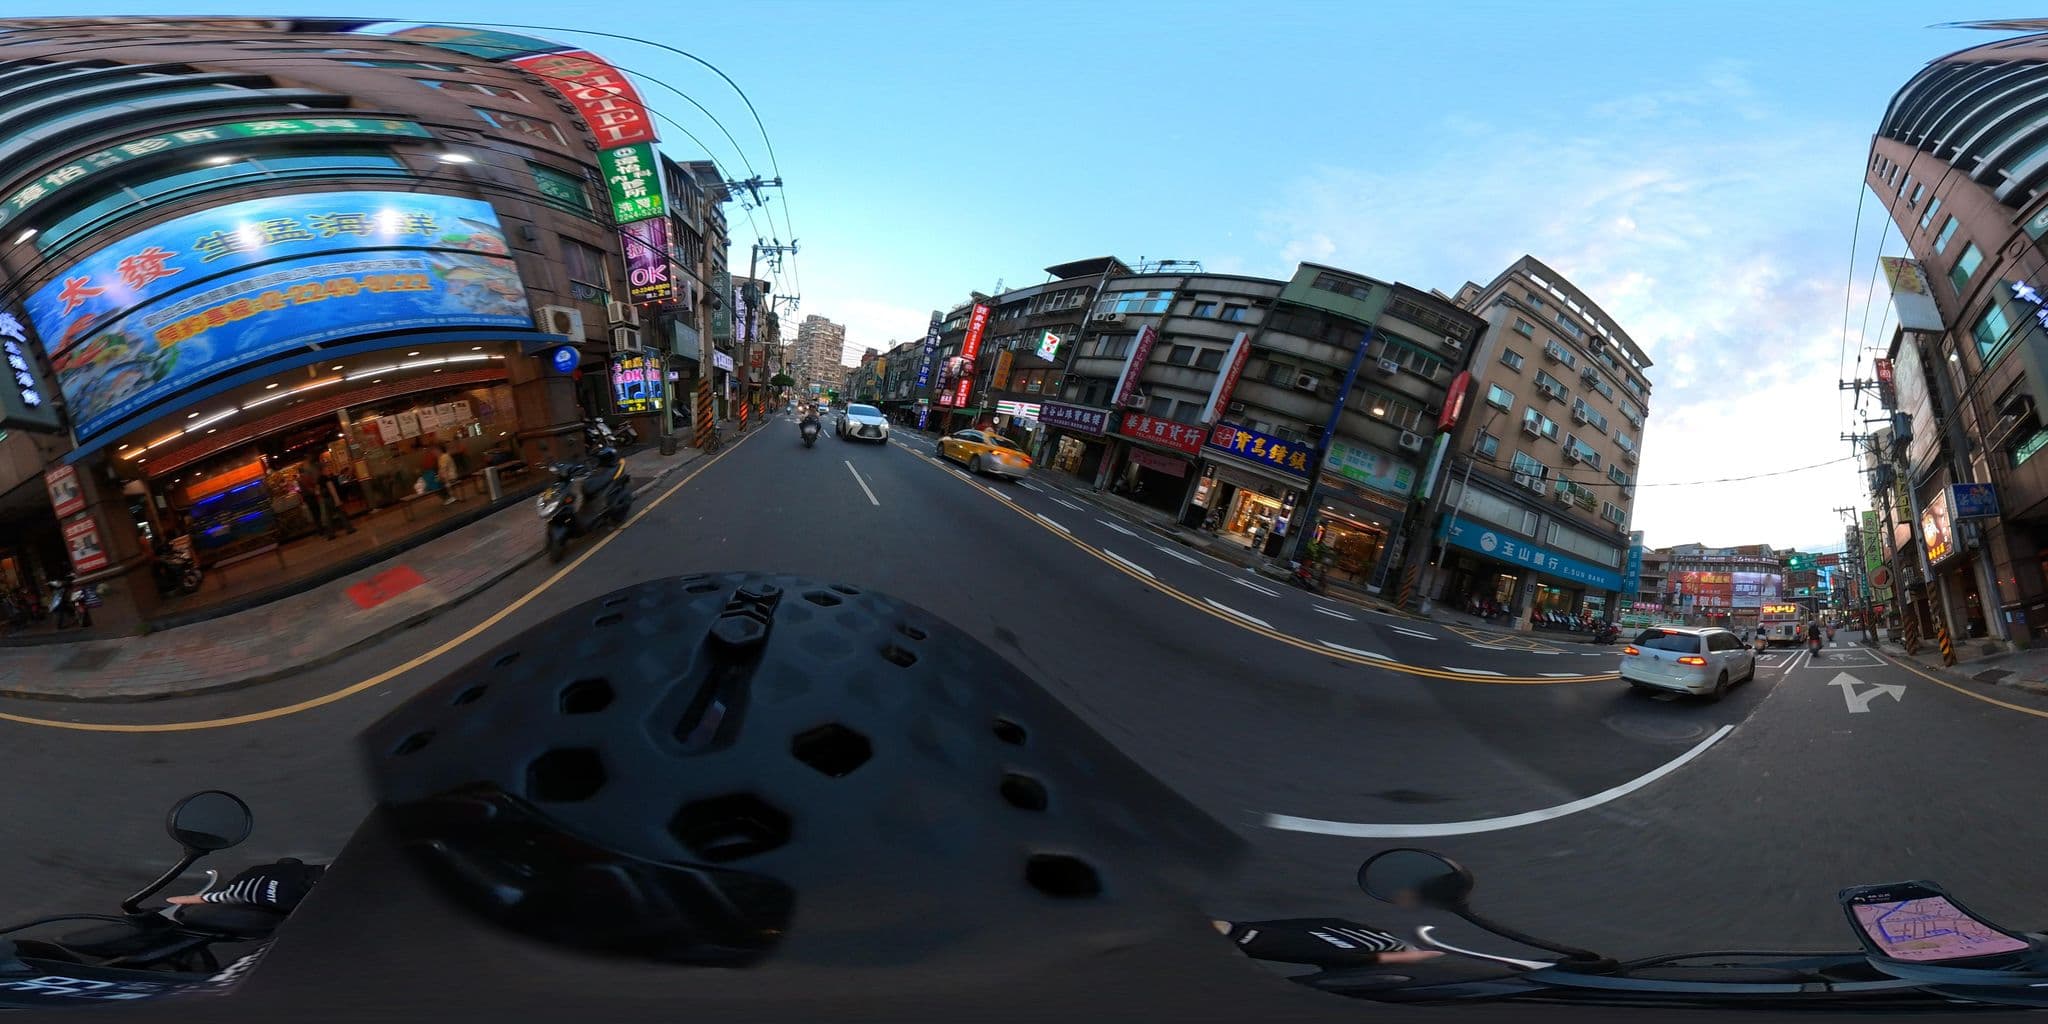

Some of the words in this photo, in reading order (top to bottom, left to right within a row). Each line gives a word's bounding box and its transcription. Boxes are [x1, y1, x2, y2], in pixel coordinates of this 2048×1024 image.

[562, 74, 645, 142] HOTEL
[1126, 414, 1201, 446] 華麗百貨行
[1502, 540, 1559, 571] 玉山銀行
[1588, 573, 1606, 584] BANK
[1628, 551, 1638, 588] 玉山銀行
